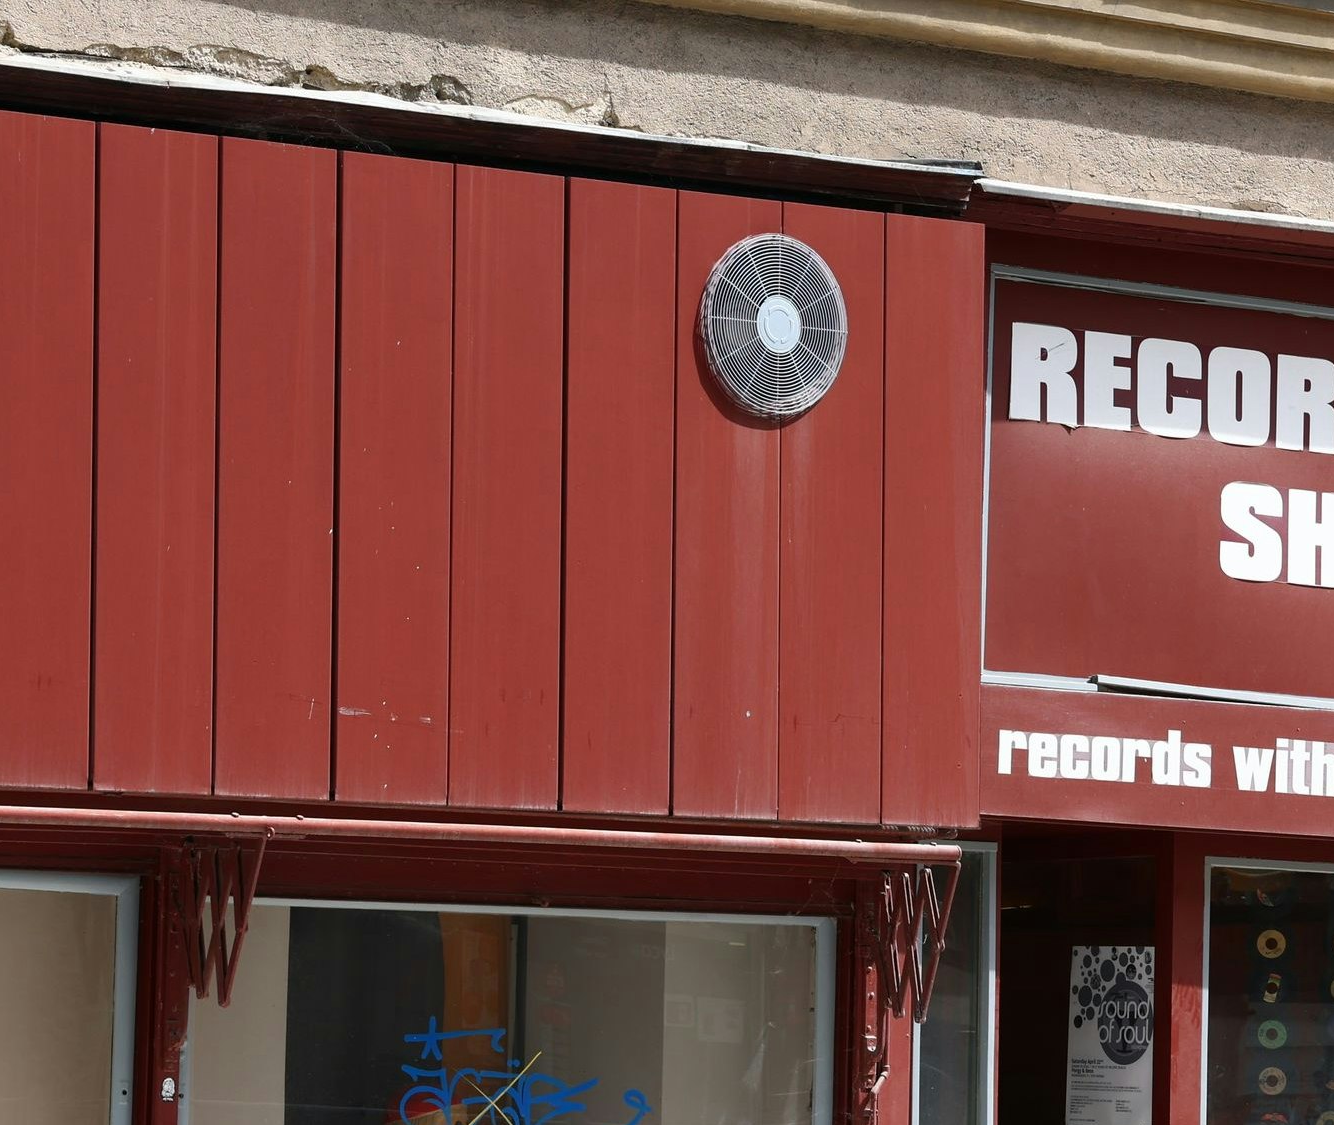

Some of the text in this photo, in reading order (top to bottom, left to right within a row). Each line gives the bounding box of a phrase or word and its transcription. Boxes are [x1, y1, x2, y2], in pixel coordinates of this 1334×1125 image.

[997, 729, 1212, 790] records
[1097, 998, 1151, 1019] sound
[1099, 1018, 1152, 1044] of soul
